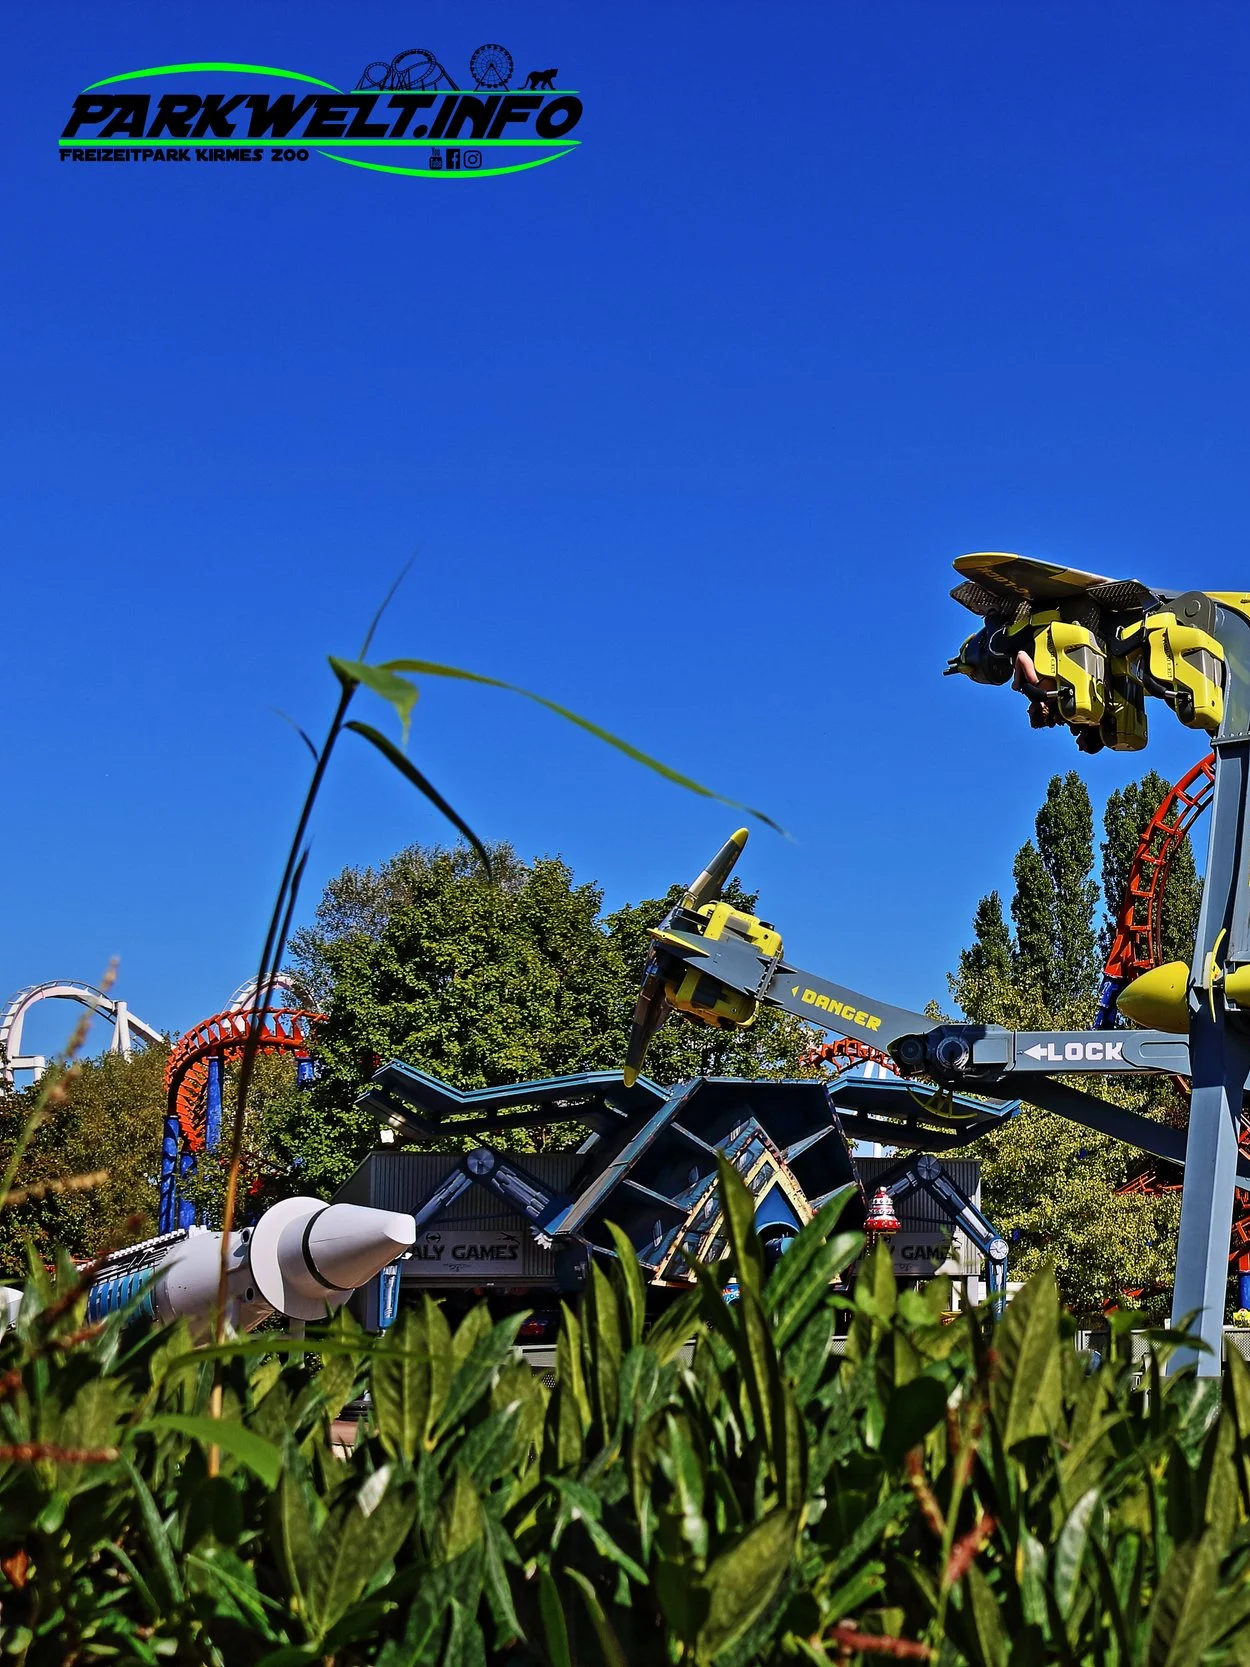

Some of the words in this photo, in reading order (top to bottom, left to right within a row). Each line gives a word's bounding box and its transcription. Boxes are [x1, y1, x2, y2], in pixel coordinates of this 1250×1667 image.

[801, 988, 882, 1031] DANGER
[1047, 1041, 1123, 1061] LOCK
[451, 1244, 519, 1260] GAMES
